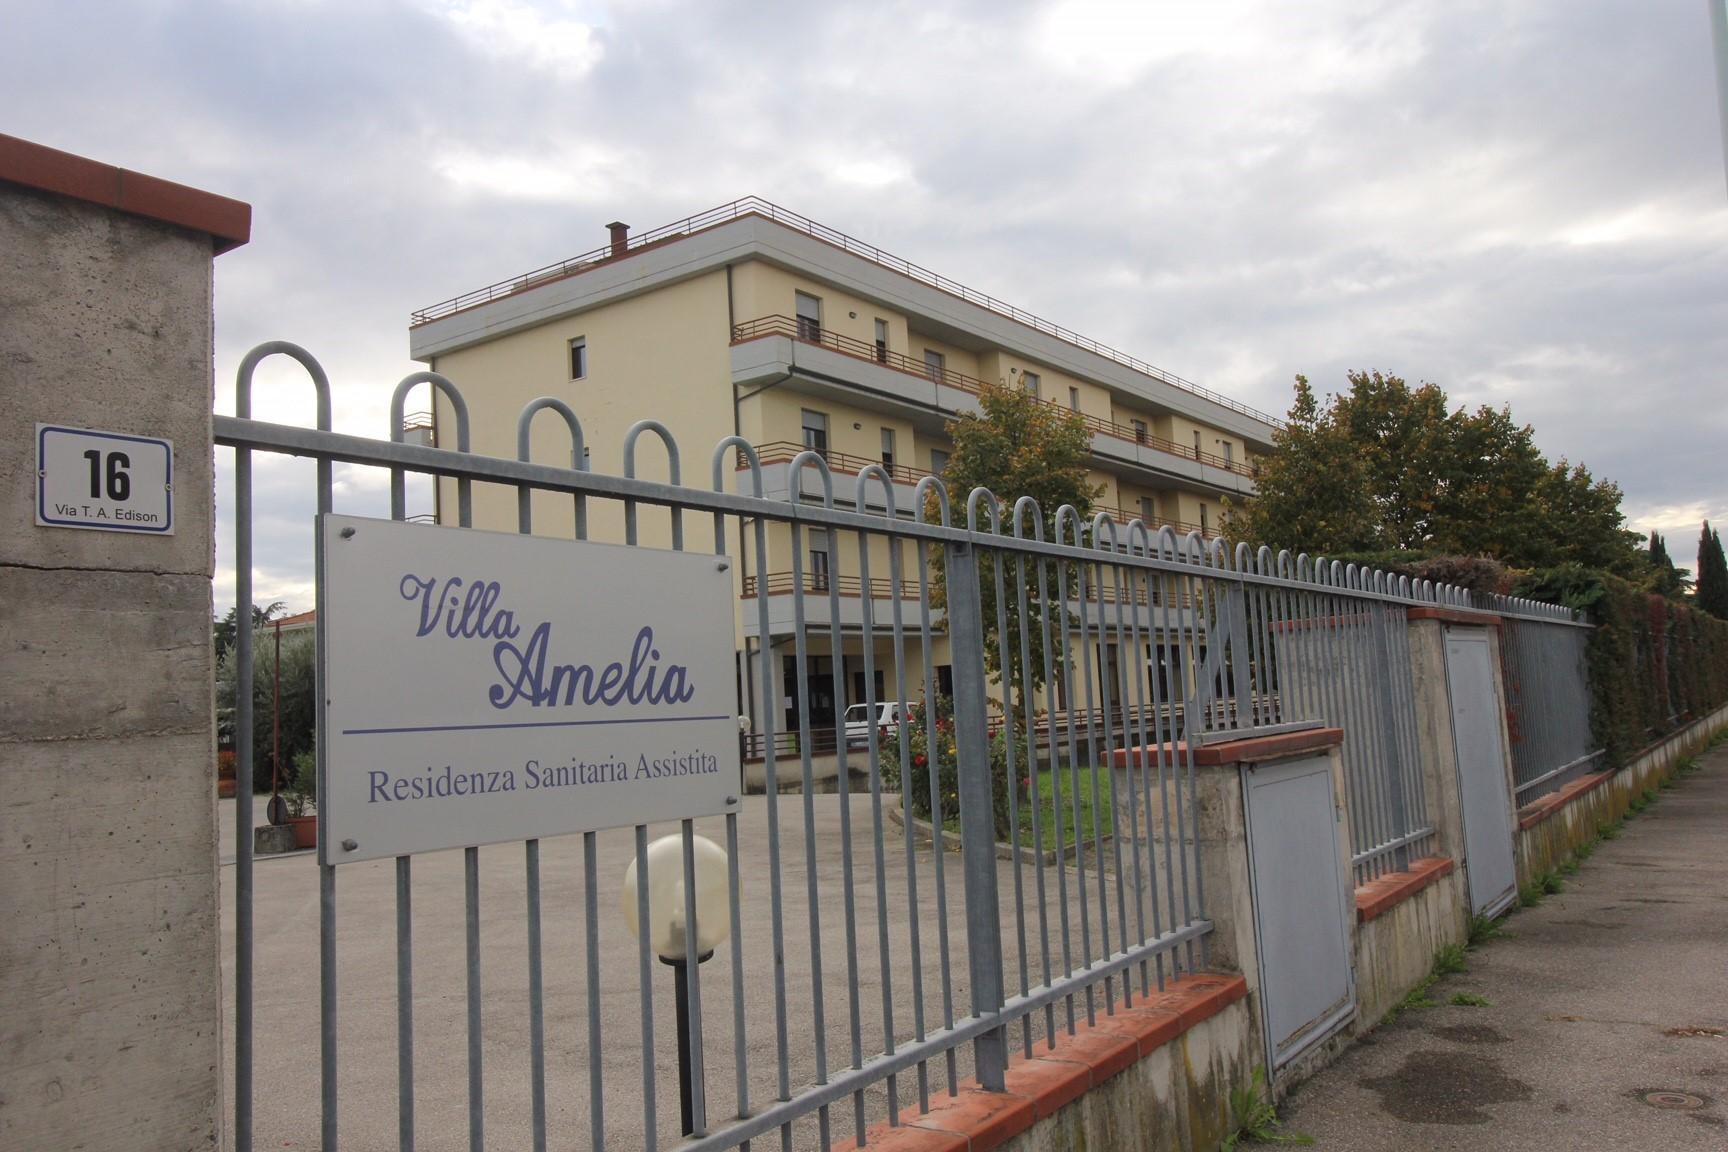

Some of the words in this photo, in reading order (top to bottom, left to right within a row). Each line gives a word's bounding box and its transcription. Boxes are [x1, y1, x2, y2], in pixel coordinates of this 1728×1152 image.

[84, 449, 131, 501] 16
[55, 503, 77, 516] Via
[82, 505, 93, 517] T.
[97, 507, 110, 519] A.
[115, 508, 158, 523] Edison
[400, 573, 520, 639] Villa
[488, 621, 694, 710] Amelia
[367, 765, 515, 803] Residenza
[525, 755, 628, 790] Sanitaria
[634, 748, 718, 780] Assistita
